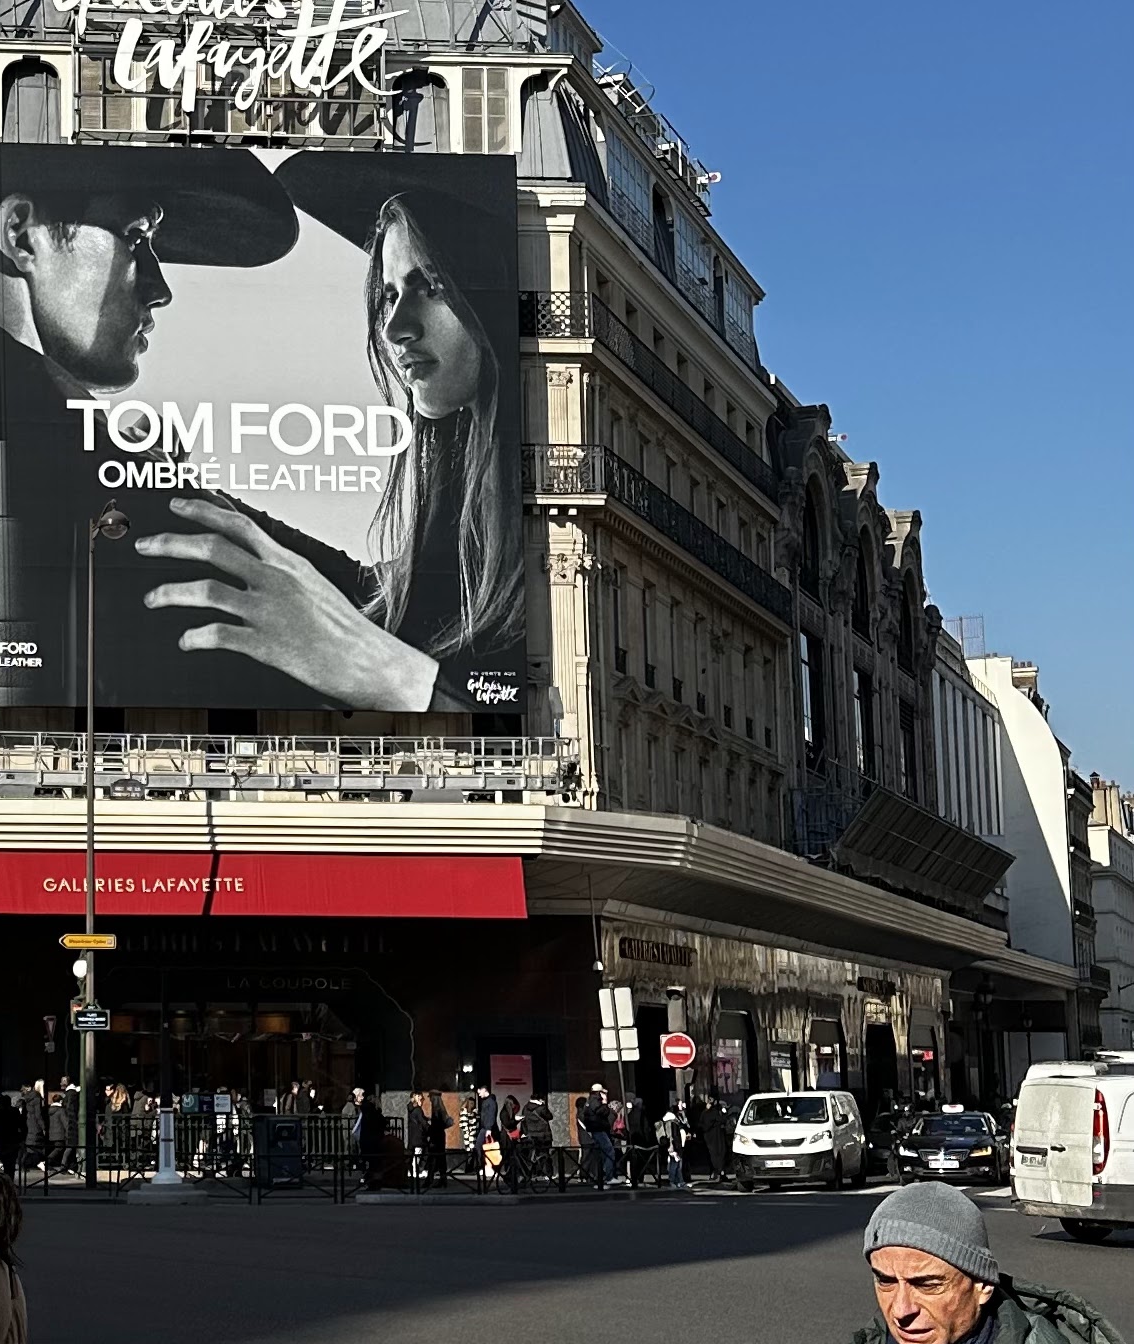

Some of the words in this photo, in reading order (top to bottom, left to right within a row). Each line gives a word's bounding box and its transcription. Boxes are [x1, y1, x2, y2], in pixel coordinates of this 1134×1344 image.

[66, 399, 213, 453] TOM
[230, 403, 413, 457] FORD
[98, 457, 221, 490] OMBRÉ
[228, 463, 383, 493] LEATHER
[0, 642, 38, 655] FORD
[141, 877, 245, 893] LAFAYETTE
